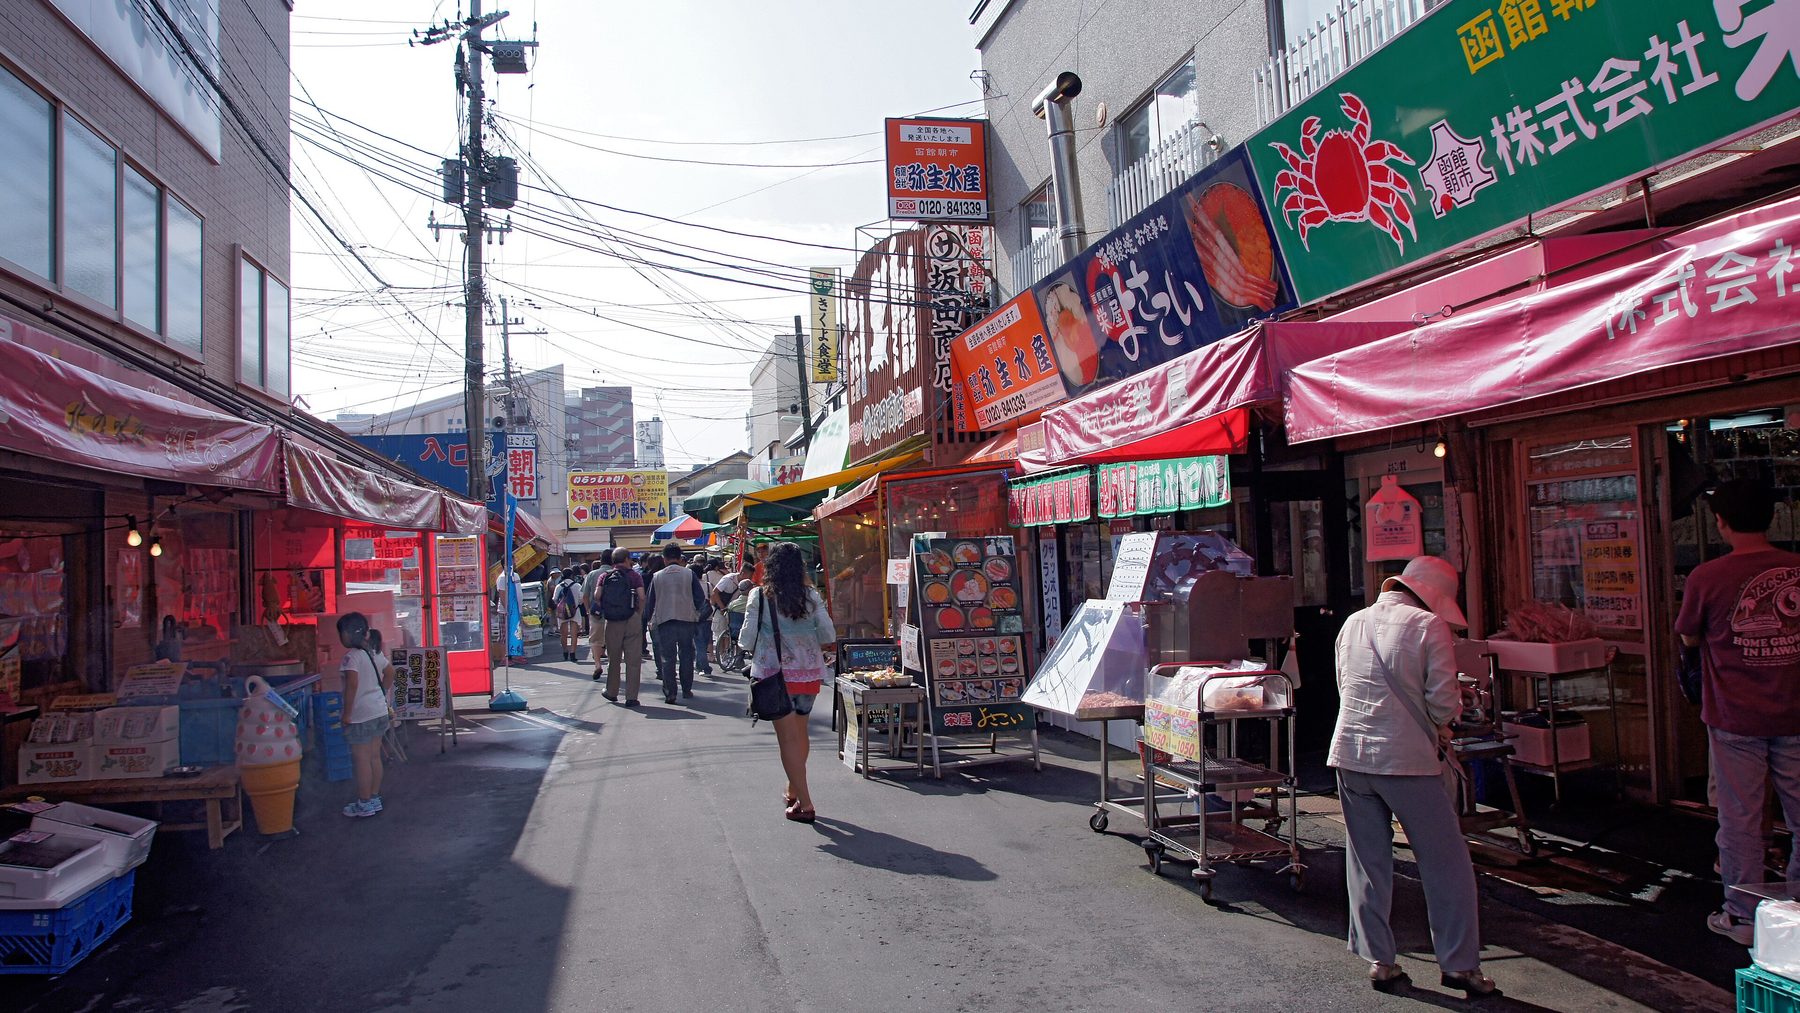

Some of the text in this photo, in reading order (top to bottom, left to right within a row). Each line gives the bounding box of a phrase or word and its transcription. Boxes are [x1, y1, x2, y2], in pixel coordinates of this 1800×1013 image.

[1490, 19, 1719, 176] 株式会社
[908, 134, 965, 143] 発送いたします。
[917, 126, 955, 134] 全国各地へ
[915, 147, 959, 157] 函館朝市
[1436, 146, 1468, 177] 函館
[907, 162, 982, 193] 弥生水産
[1442, 166, 1474, 195] 朝市
[968, 227, 986, 294] 函館朝市
[1605, 238, 1800, 340] 株式会社
[817, 297, 832, 375] きくよ食堂
[978, 333, 1053, 398] 弥生水産
[1079, 398, 1128, 437] 株式会社
[419, 436, 468, 466] 入口
[507, 435, 536, 447] はこだて
[508, 449, 536, 497] 朝市
[570, 487, 636, 502] ようこそ函館朝市へ
[590, 501, 666, 520] 仲通り・朝市ドーム
[1042, 542, 1052, 629] クラシック
[1047, 542, 1058, 611] サッポロ
[1733, 636, 1768, 647] HOME
[1743, 647, 1759, 657] IN
[424, 649, 441, 709] いか釣り体験
[943, 711, 973, 727] 栄屋
[1177, 739, 1195, 757] 1050
